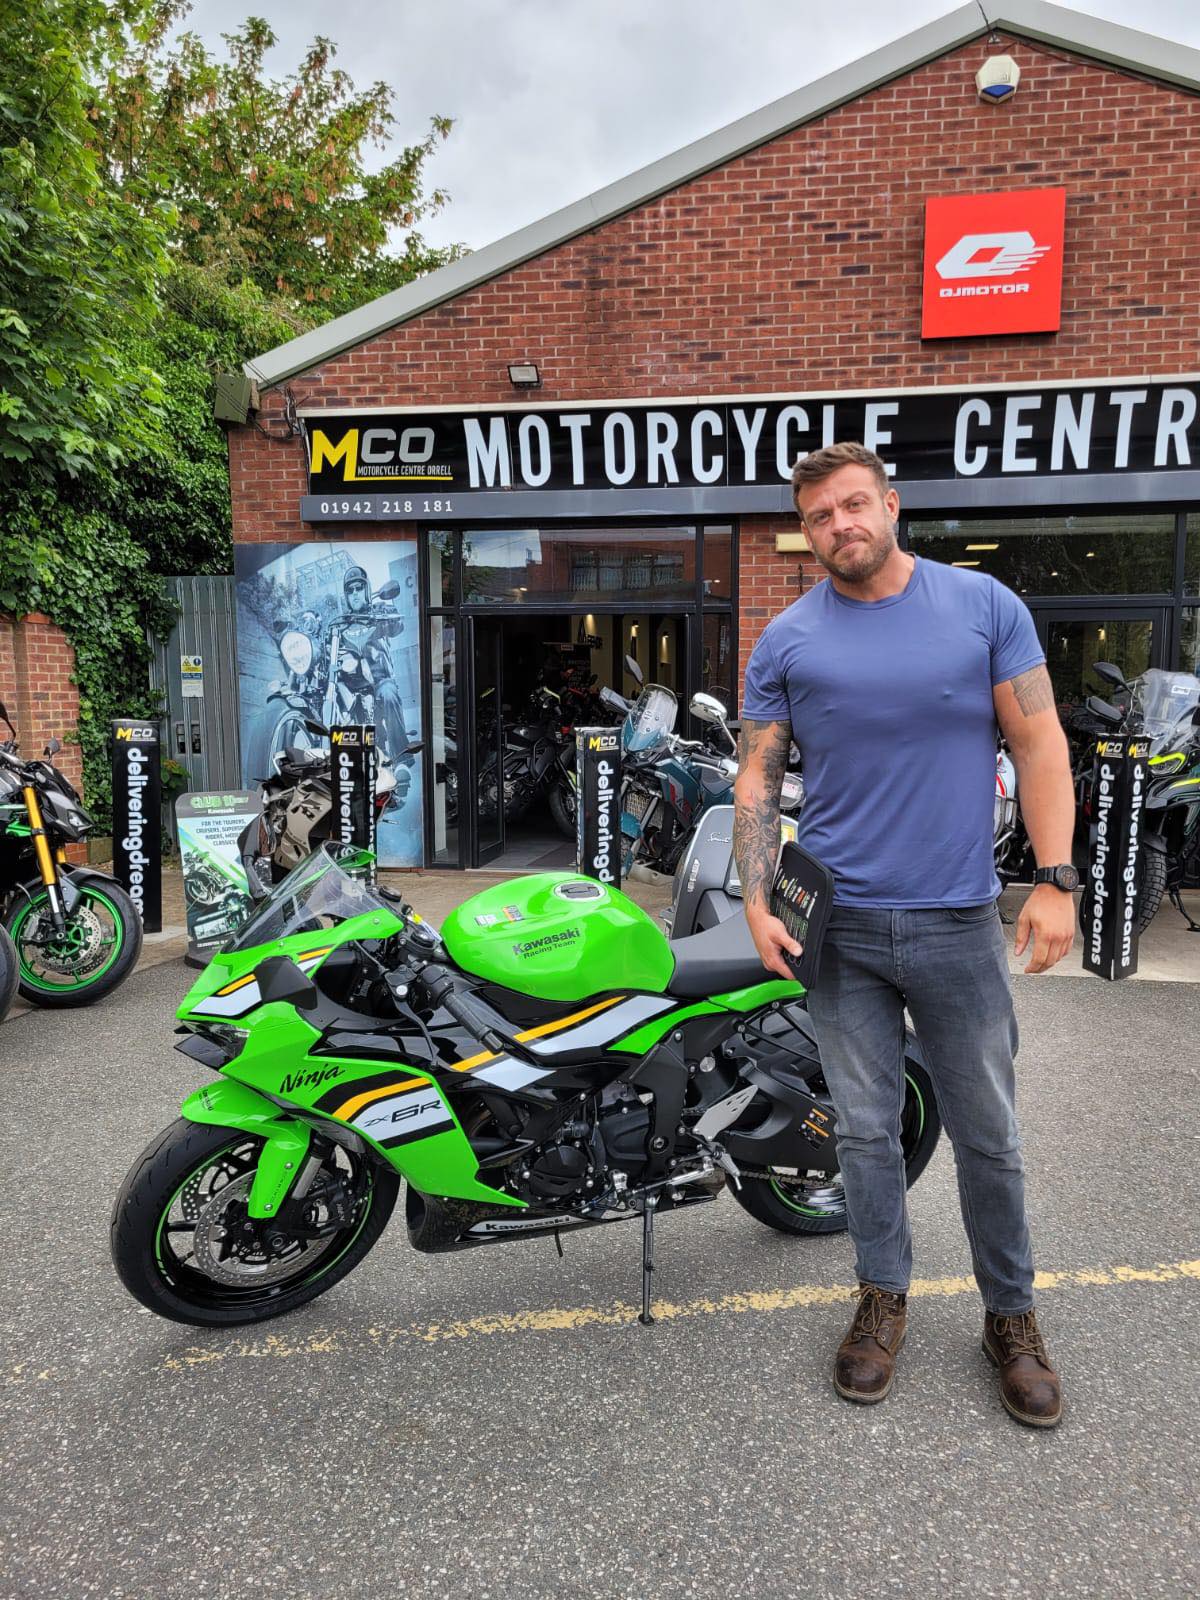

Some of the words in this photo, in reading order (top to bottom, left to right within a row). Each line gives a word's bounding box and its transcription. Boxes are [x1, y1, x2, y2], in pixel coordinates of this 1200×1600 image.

[939, 283, 1030, 298] QJMOTOR
[310, 427, 436, 482] MCO
[357, 465, 400, 477] MOTORCYCLE
[401, 465, 425, 476] CENTRE
[427, 464, 452, 476] ORRELL
[320, 501, 372, 514] 01942
[382, 500, 413, 513] 218
[423, 500, 453, 512] 181
[116, 727, 153, 742] MCO
[332, 731, 357, 743] MCO
[589, 736, 617, 751] MCO
[1096, 741, 1123, 757] MCO
[1128, 743, 1149, 758] MCO
[121, 747, 149, 925] deliveringdream
[1091, 763, 1115, 966] deliveringdreams
[1121, 763, 1144, 968] deliveringdreams
[512, 927, 581, 956] Kawasaki
[523, 945, 553, 960] Racing
[554, 939, 576, 949] Team
[279, 1063, 346, 1094] Ninja
[485, 1216, 570, 1231] Kawasaki
